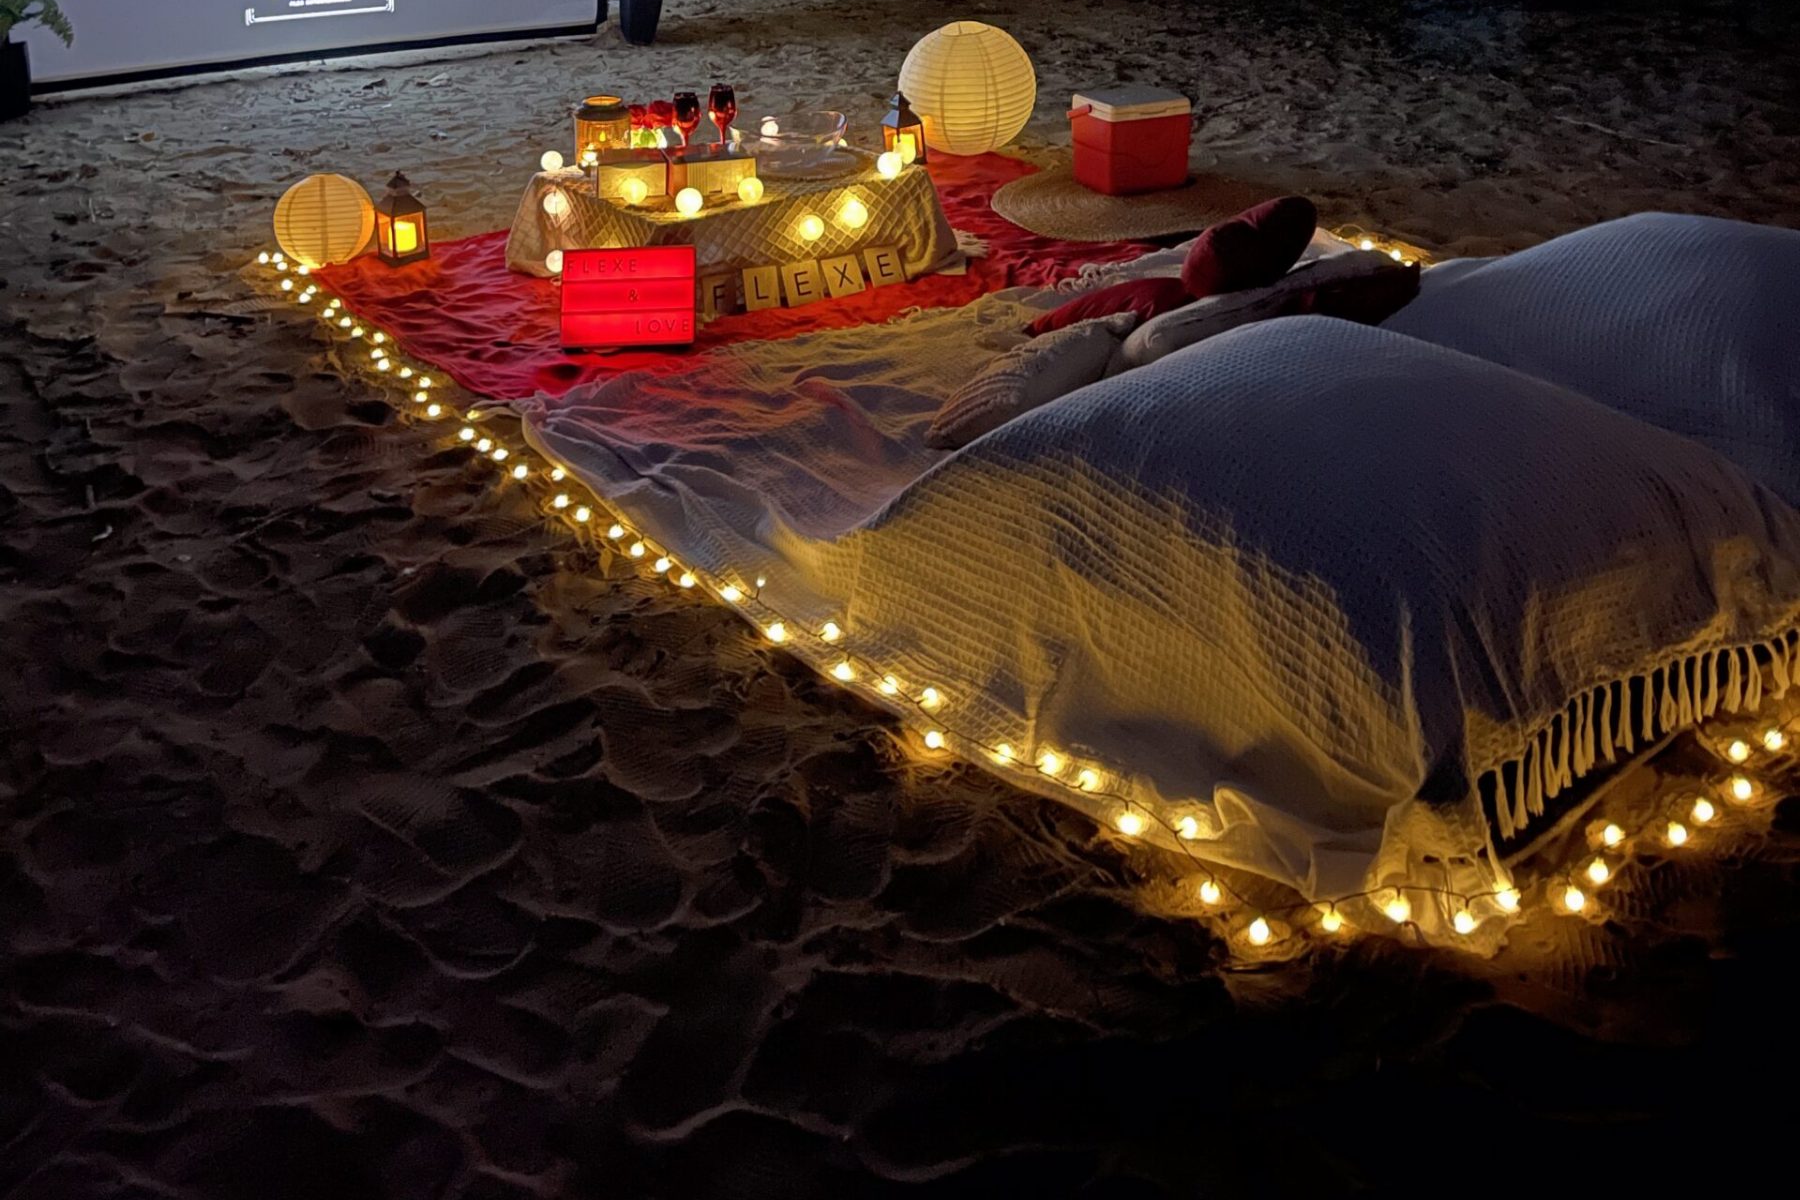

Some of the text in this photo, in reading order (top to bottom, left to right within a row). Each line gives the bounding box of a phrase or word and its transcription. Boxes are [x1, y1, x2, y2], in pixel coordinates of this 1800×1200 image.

[567, 258, 638, 274] FLEXE
[628, 289, 639, 304] &
[635, 318, 691, 336] LOVE
